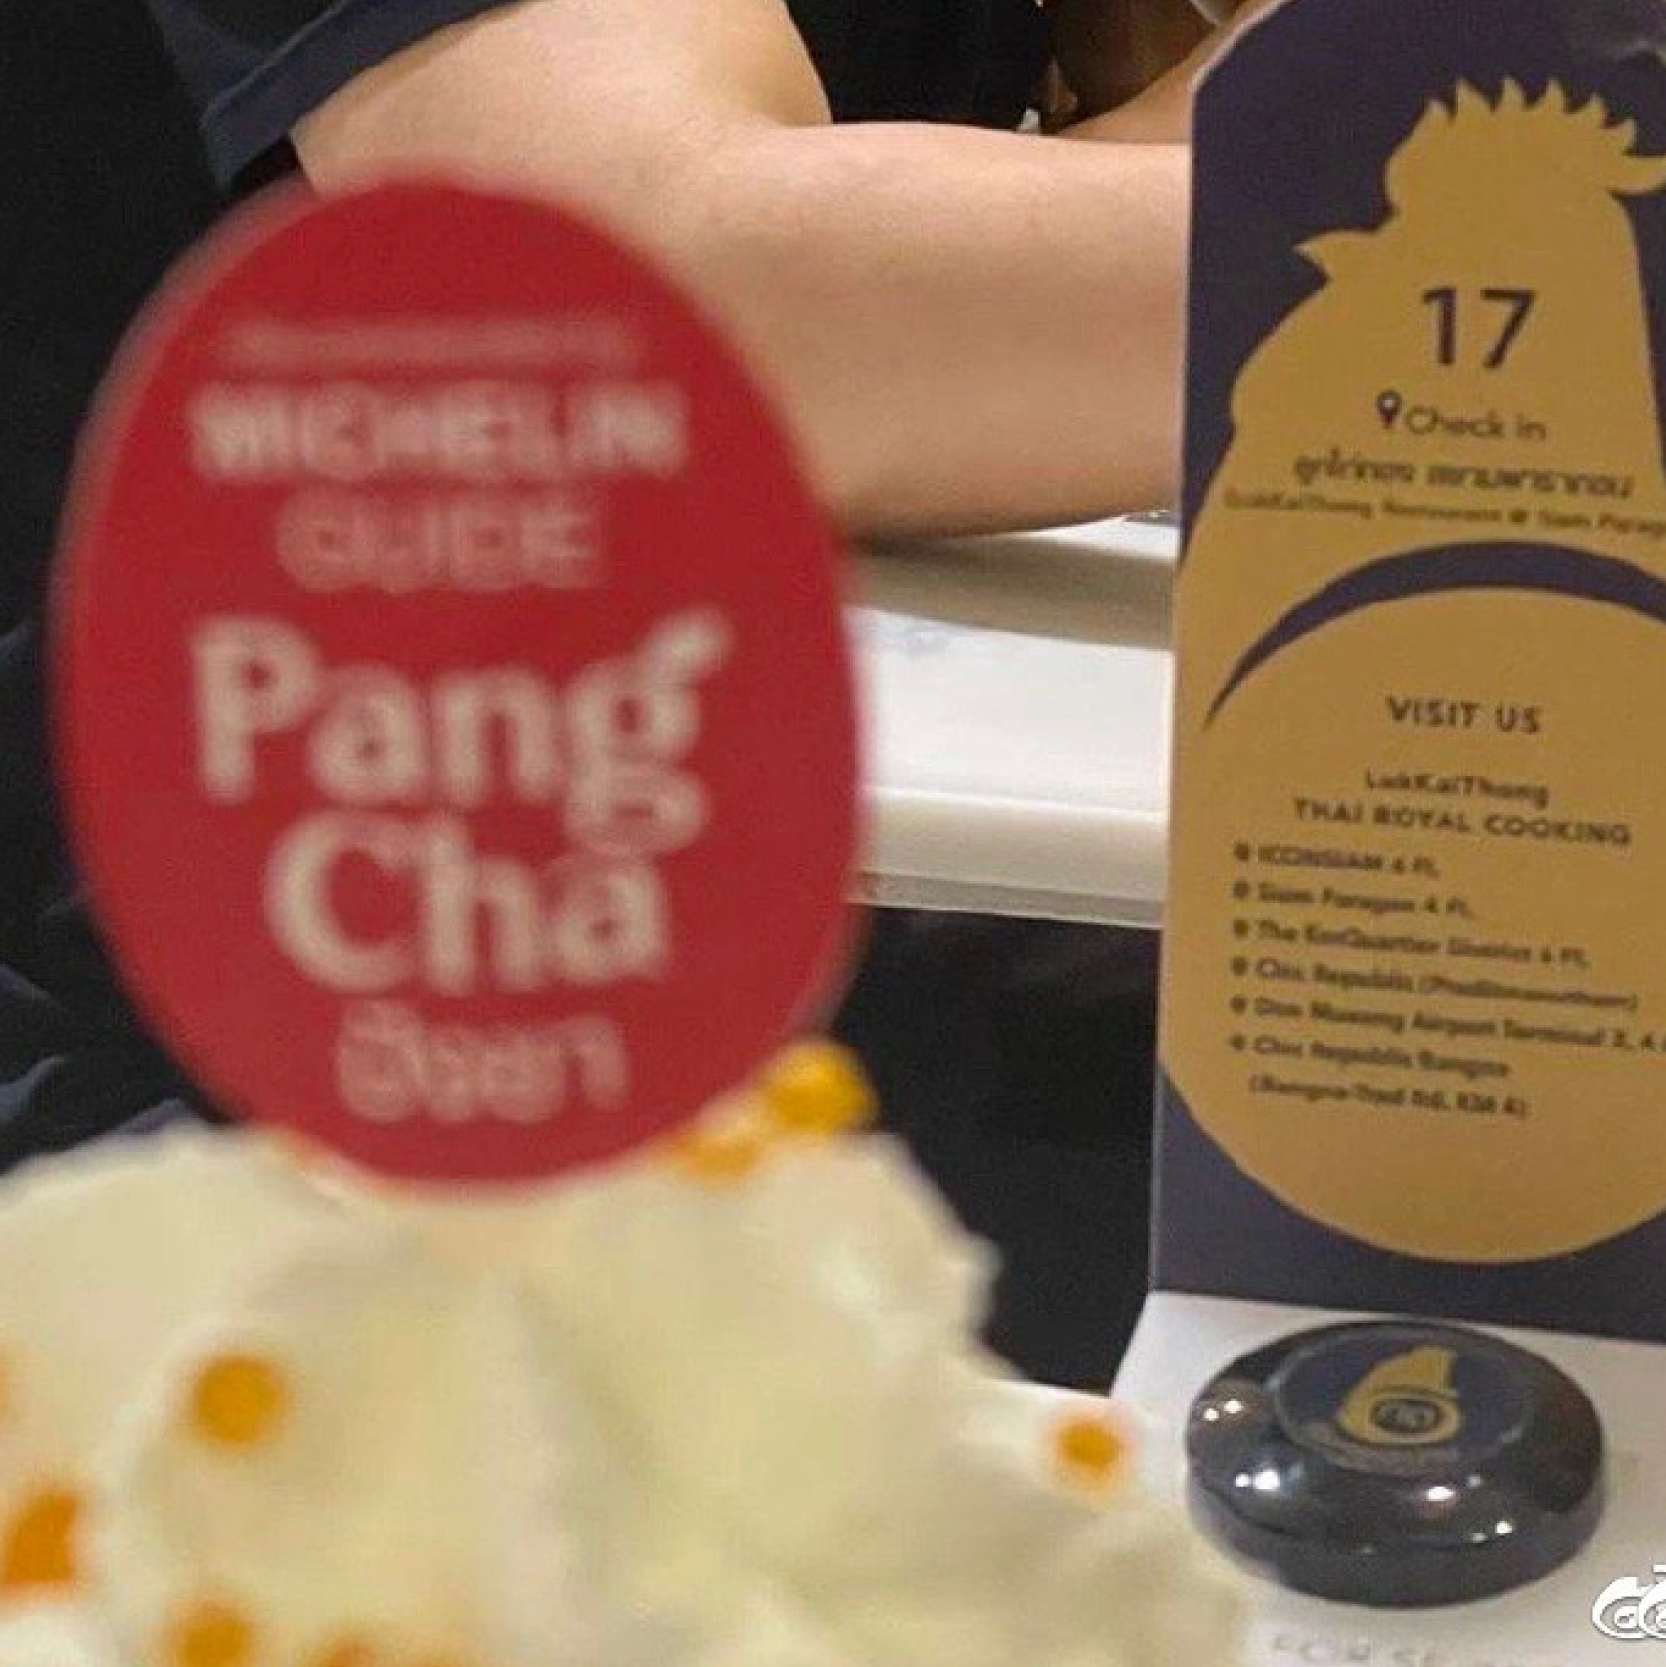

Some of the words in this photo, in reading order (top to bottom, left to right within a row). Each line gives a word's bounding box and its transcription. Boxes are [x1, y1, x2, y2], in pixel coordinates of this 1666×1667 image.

[1421, 287, 1537, 369] 17
[1405, 404, 1504, 439] Check
[189, 604, 731, 859] Pang
[1385, 695, 1480, 728] VISIT
[1495, 701, 1543, 734] US
[1293, 797, 1364, 824] THAI
[1372, 804, 1470, 833] ROYAL
[1484, 813, 1632, 846] COOKING
[266, 808, 674, 996] Cha
